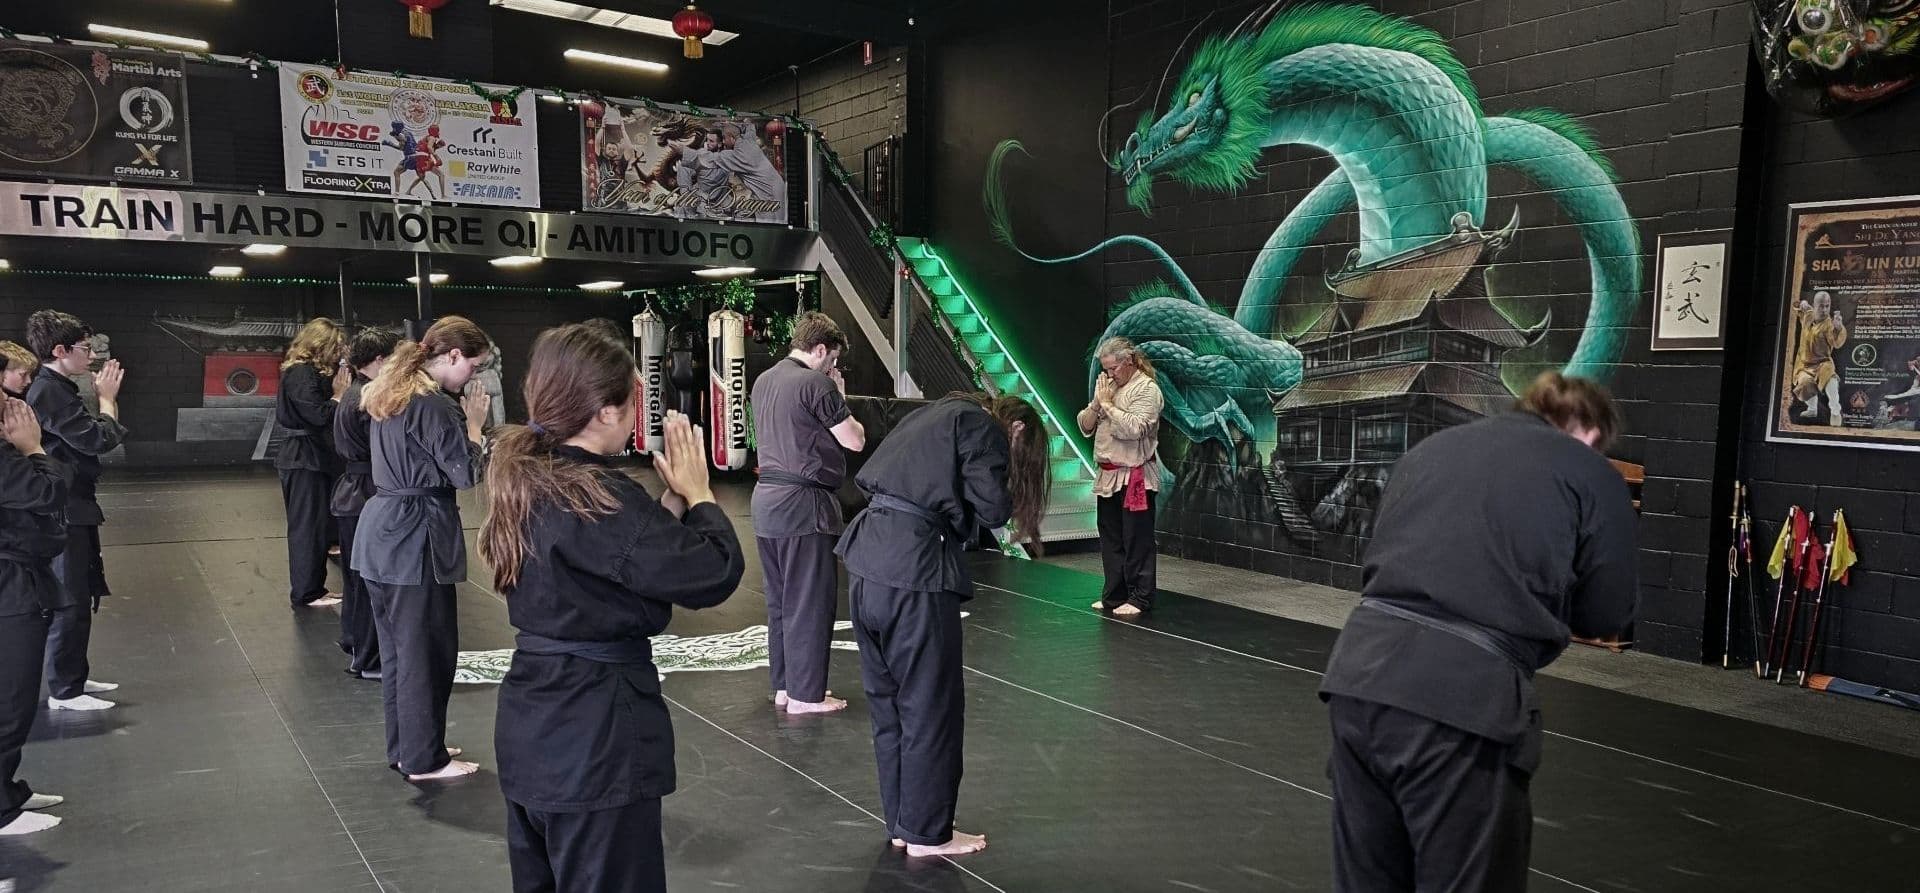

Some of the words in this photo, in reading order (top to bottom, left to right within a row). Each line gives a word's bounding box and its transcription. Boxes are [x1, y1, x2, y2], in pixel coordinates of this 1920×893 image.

[112, 62, 154, 75] Martial
[157, 67, 182, 78] Arts
[403, 79, 433, 91] TEAM
[433, 83, 475, 95] SPONS
[354, 91, 391, 102] WORLD
[435, 99, 491, 112] MALAYSIA
[116, 131, 135, 140] KUNG
[136, 132, 147, 140] FU
[147, 133, 162, 141] FOR
[309, 119, 380, 142] WSC
[311, 138, 334, 146] WESTERN
[356, 142, 380, 151] CONCRETE
[447, 143, 496, 157] Crestani
[498, 148, 523, 160] Built
[337, 155, 366, 168] ETS
[371, 157, 384, 169] IT
[114, 166, 165, 177] GAMMA
[170, 169, 179, 177] X
[591, 178, 650, 210] Year
[675, 188, 701, 209] the
[705, 185, 780, 218] Dragon
[20, 194, 174, 232] TRAIN
[193, 202, 325, 238] HARD
[359, 211, 484, 245] MORE
[498, 219, 537, 249] QI
[567, 223, 754, 261] AMITUOFO
[649, 355, 664, 437] MORGAN
[730, 357, 746, 450] MORGAN
